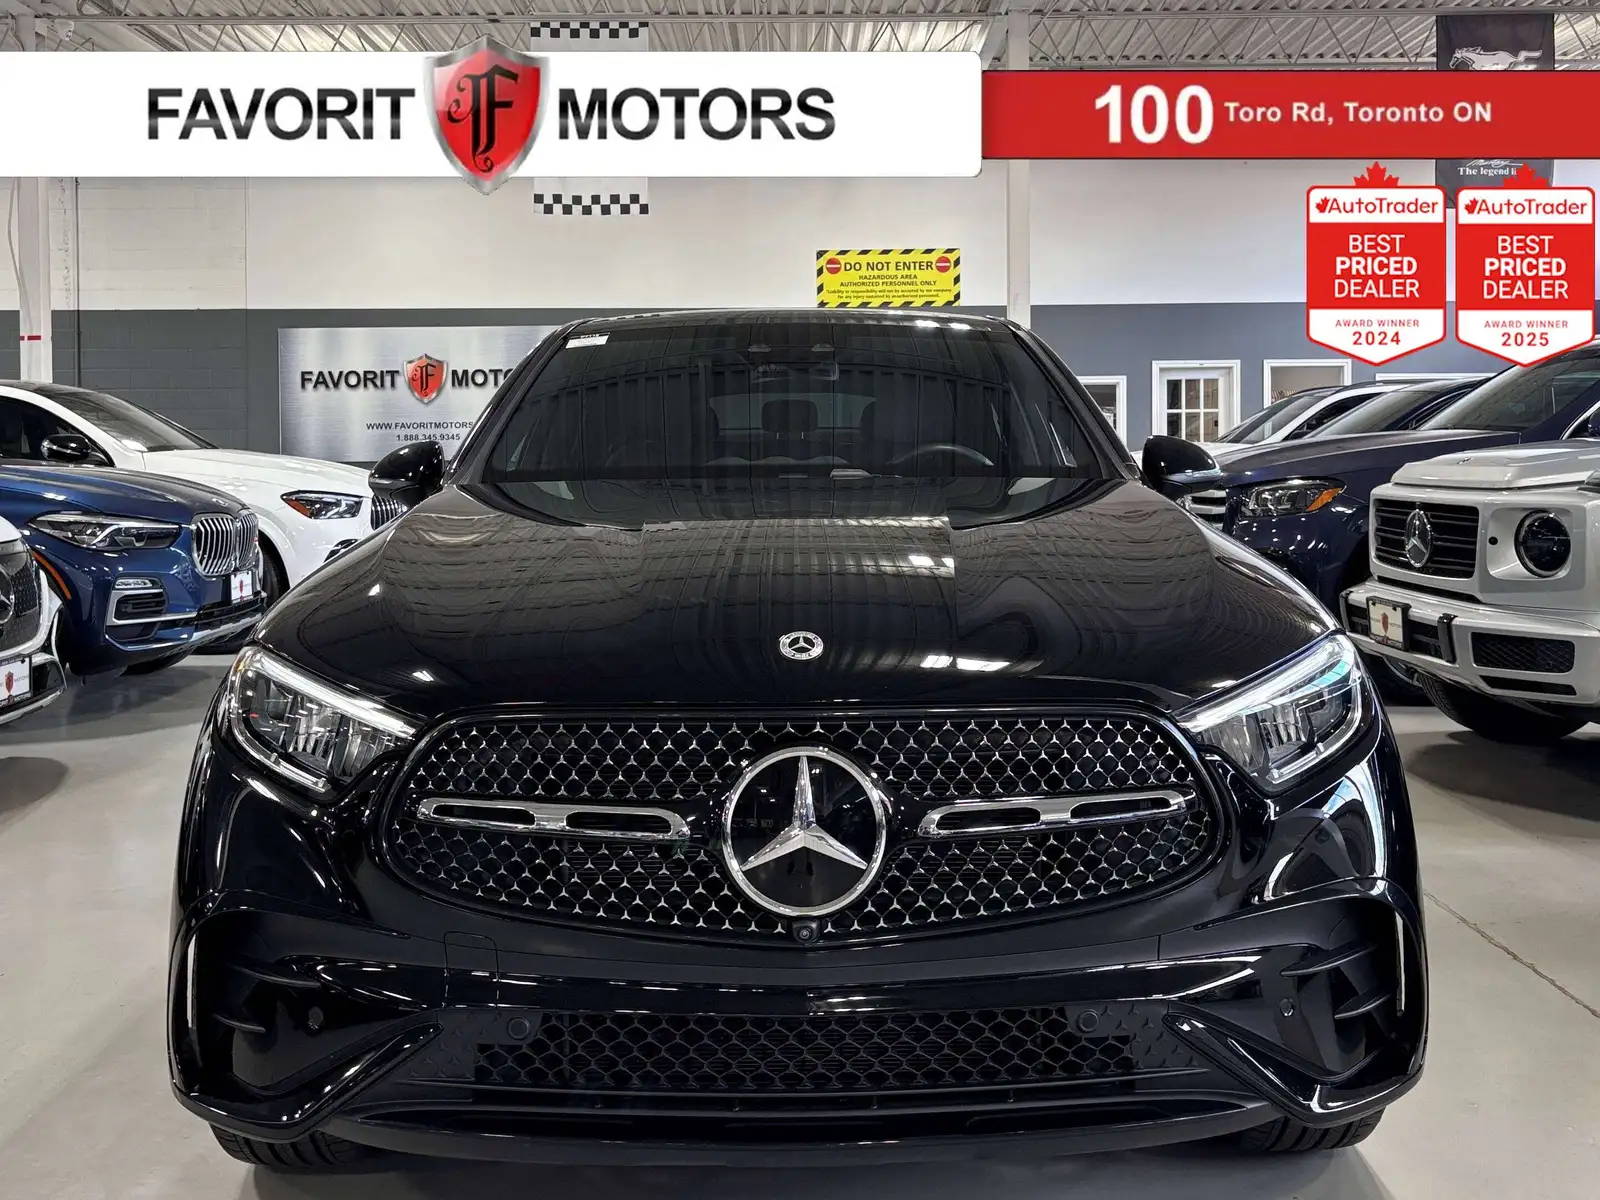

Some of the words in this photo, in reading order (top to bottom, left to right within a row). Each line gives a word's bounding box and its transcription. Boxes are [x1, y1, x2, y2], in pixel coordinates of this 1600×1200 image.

[1458, 167, 1478, 175] The
[1480, 166, 1509, 176] legend
[844, 261, 862, 271] DO
[866, 261, 891, 271] NOT
[895, 260, 933, 271] ENTER
[300, 370, 399, 389] FAVORIT
[396, 433, 461, 441] 1.888.345.9345
